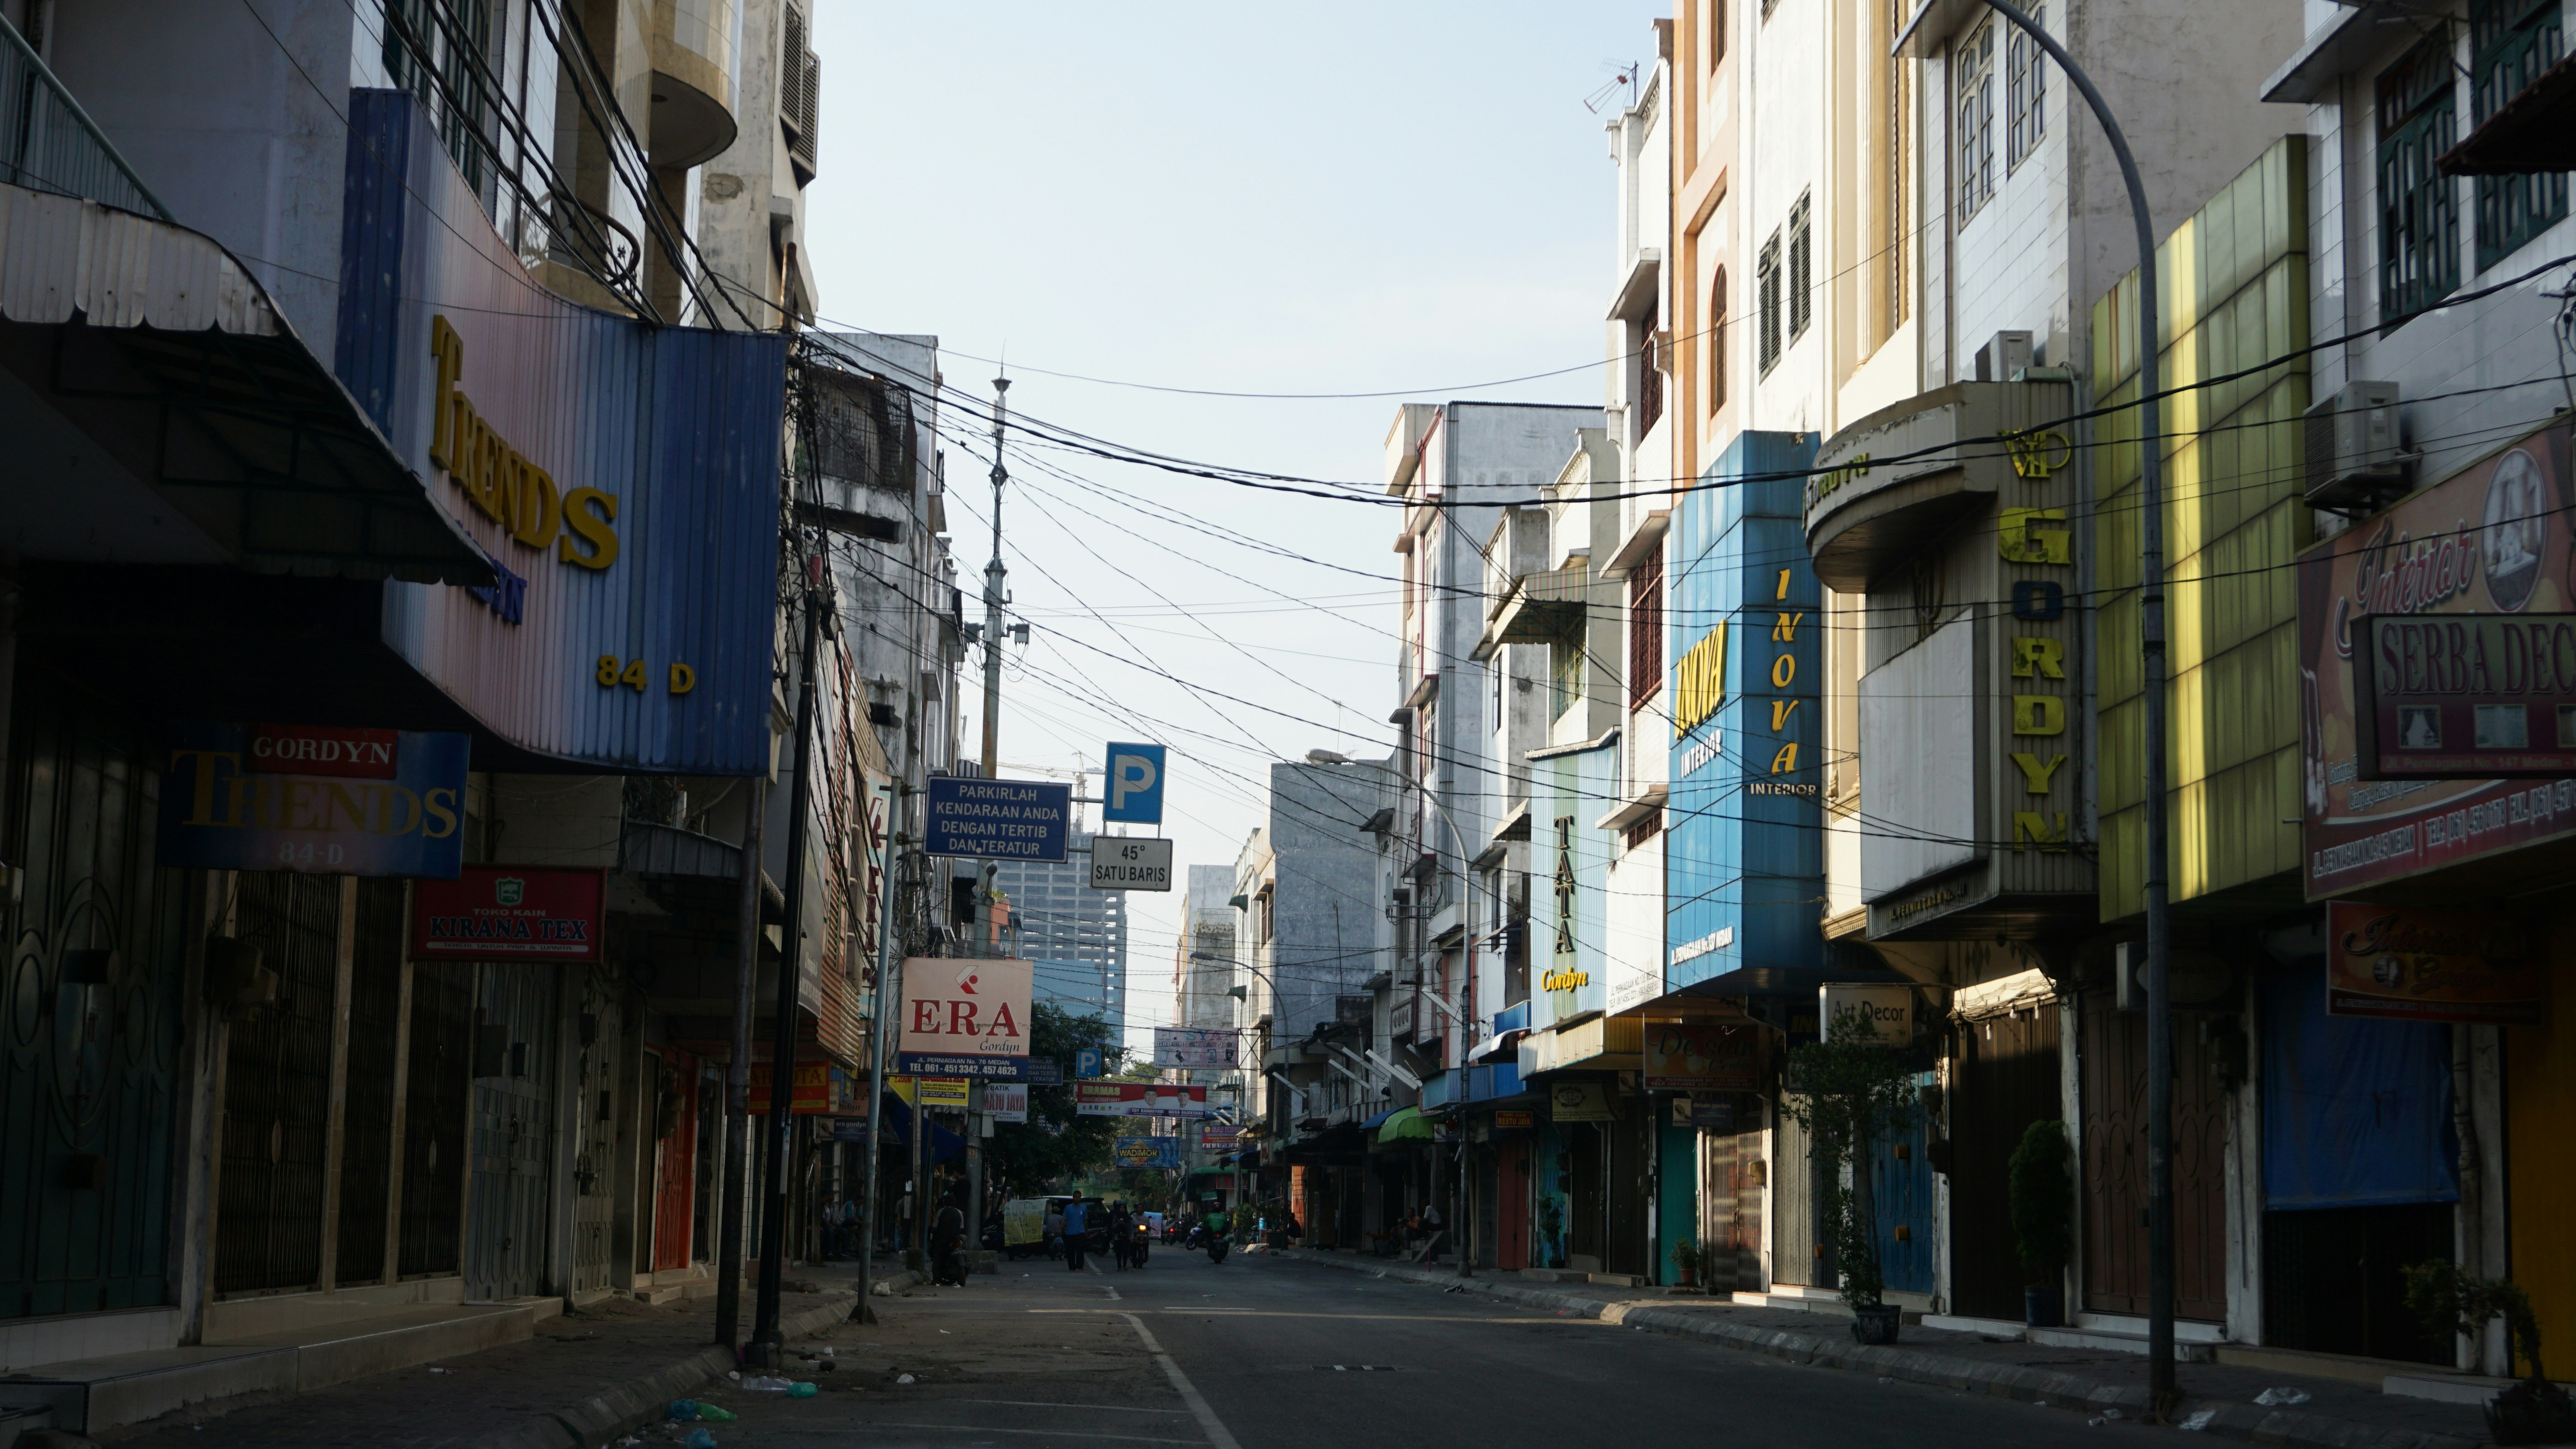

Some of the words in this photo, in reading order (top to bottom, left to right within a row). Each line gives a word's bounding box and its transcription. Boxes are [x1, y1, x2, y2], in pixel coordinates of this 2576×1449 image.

[430, 315, 619, 570] TRENDS
[2356, 516, 2476, 615] Interior
[2381, 621, 2496, 695] SERBA
[597, 655, 646, 691] 84
[670, 662, 695, 693] D
[1675, 618, 1728, 740] INOVA
[1771, 569, 1802, 774] INOVA
[252, 736, 393, 765] GORDYN
[1681, 730, 1723, 778] INTERIOR
[2404, 757, 2471, 771] Perniagaan
[2498, 757, 2518, 768] 147
[2522, 756, 2562, 767] Medan
[959, 785, 1037, 801] PARKIRLAH
[1112, 754, 1156, 809] P
[1750, 784, 1817, 797] INTERIOR
[172, 749, 459, 839] TRENDS
[936, 801, 1019, 818] KENDARAAN
[1023, 807, 1060, 821] ANDA
[942, 820, 996, 836] DENGAN
[1000, 824, 1047, 838] TERTIB
[279, 842, 344, 865] 84-D
[949, 838, 976, 851] DAN
[981, 840, 1040, 855] TERATUR
[1096, 865, 1126, 880] SATU
[1129, 867, 1165, 882] BARIS
[1554, 815, 1573, 953] TATA
[473, 908, 509, 916] TOKO
[513, 909, 547, 917] KAIN
[430, 916, 532, 940] KIRANA
[538, 919, 588, 941] TEX
[1541, 967, 1589, 992] Gordyn
[909, 999, 1020, 1037] ERA
[1832, 1001, 1856, 1020] Art
[1862, 1001, 1905, 1021] Decor
[980, 1039, 1020, 1057] Gordyn
[909, 1063, 923, 1072] TEL.
[925, 1063, 939, 1073] 061
[944, 1064, 958, 1073] 451
[959, 1065, 978, 1074] 3342
[982, 1066, 997, 1075] 457
[997, 1066, 1017, 1075] 4625
[1081, 1052, 1096, 1073] P
[984, 1093, 1005, 1111] MAJU
[1007, 1094, 1025, 1112] JAYA
[1518, 1117, 1531, 1125] JAYA
